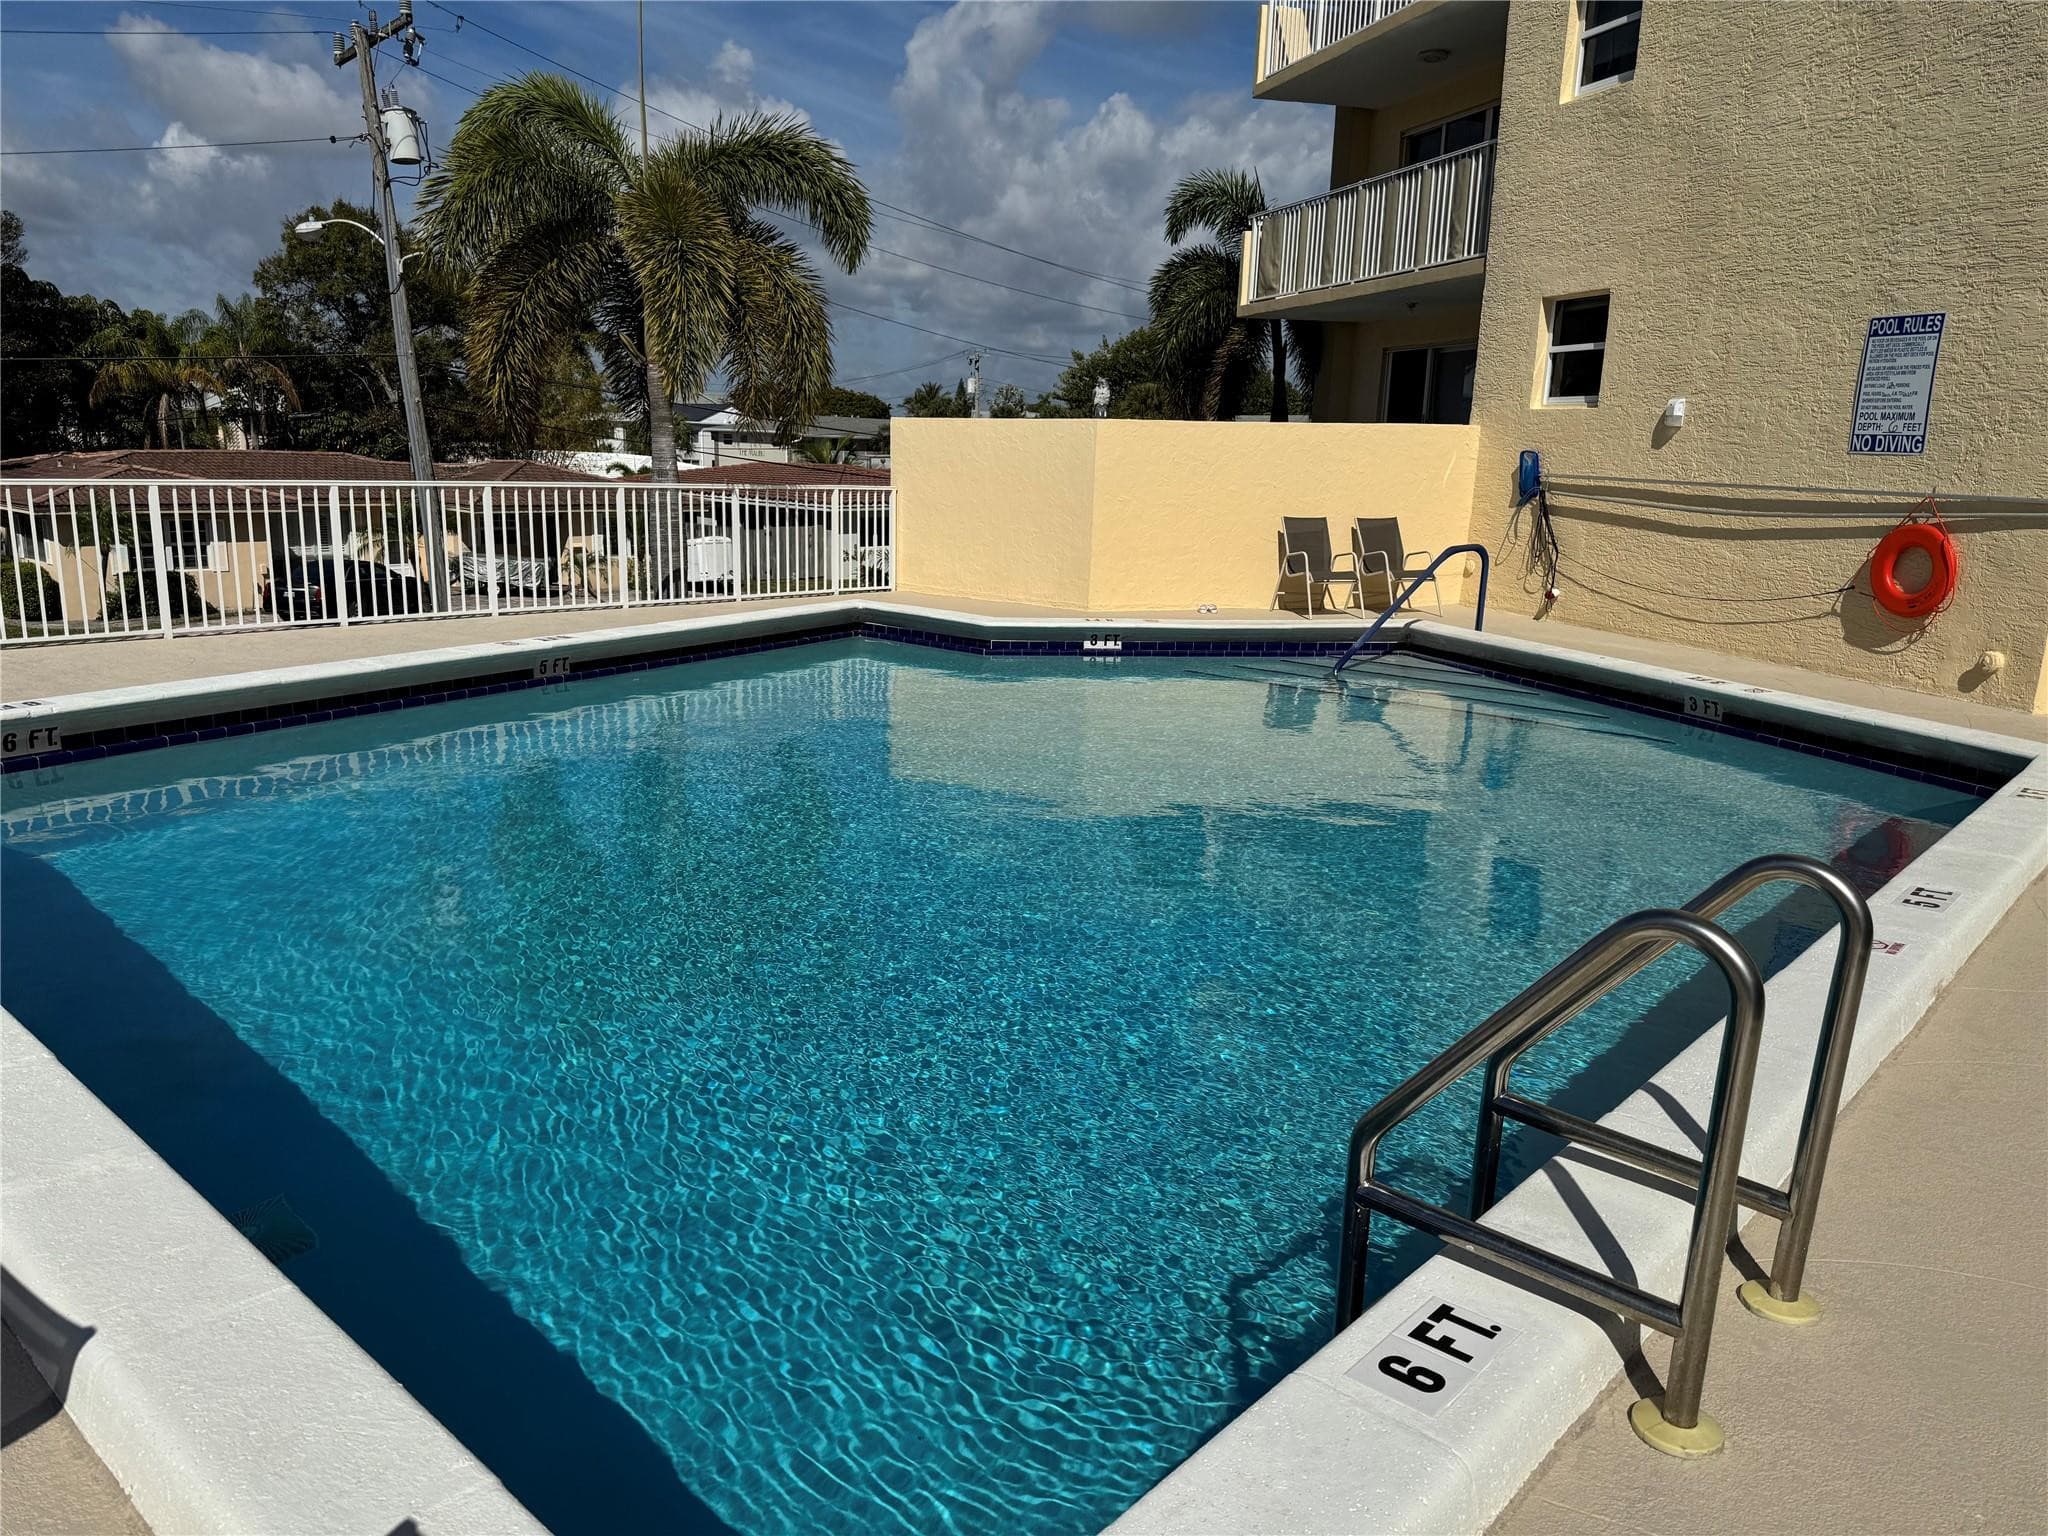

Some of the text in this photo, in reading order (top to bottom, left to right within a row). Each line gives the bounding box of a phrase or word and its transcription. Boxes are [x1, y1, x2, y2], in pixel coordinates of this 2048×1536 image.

[1870, 315, 1942, 335] POOL RULES
[1858, 412, 1916, 421] POOL MAXIMUM
[1857, 422, 1883, 432] DEPTH:
[1902, 422, 1922, 432] FEET
[1851, 435, 1923, 453] NO DIVING
[1090, 633, 1098, 647] 3
[539, 659, 548, 675] 5
[1689, 696, 1698, 712] 3
[2, 732, 17, 753] 6
[1902, 898, 1941, 909] 5
[1378, 1303, 1502, 1393] 6 FT.
